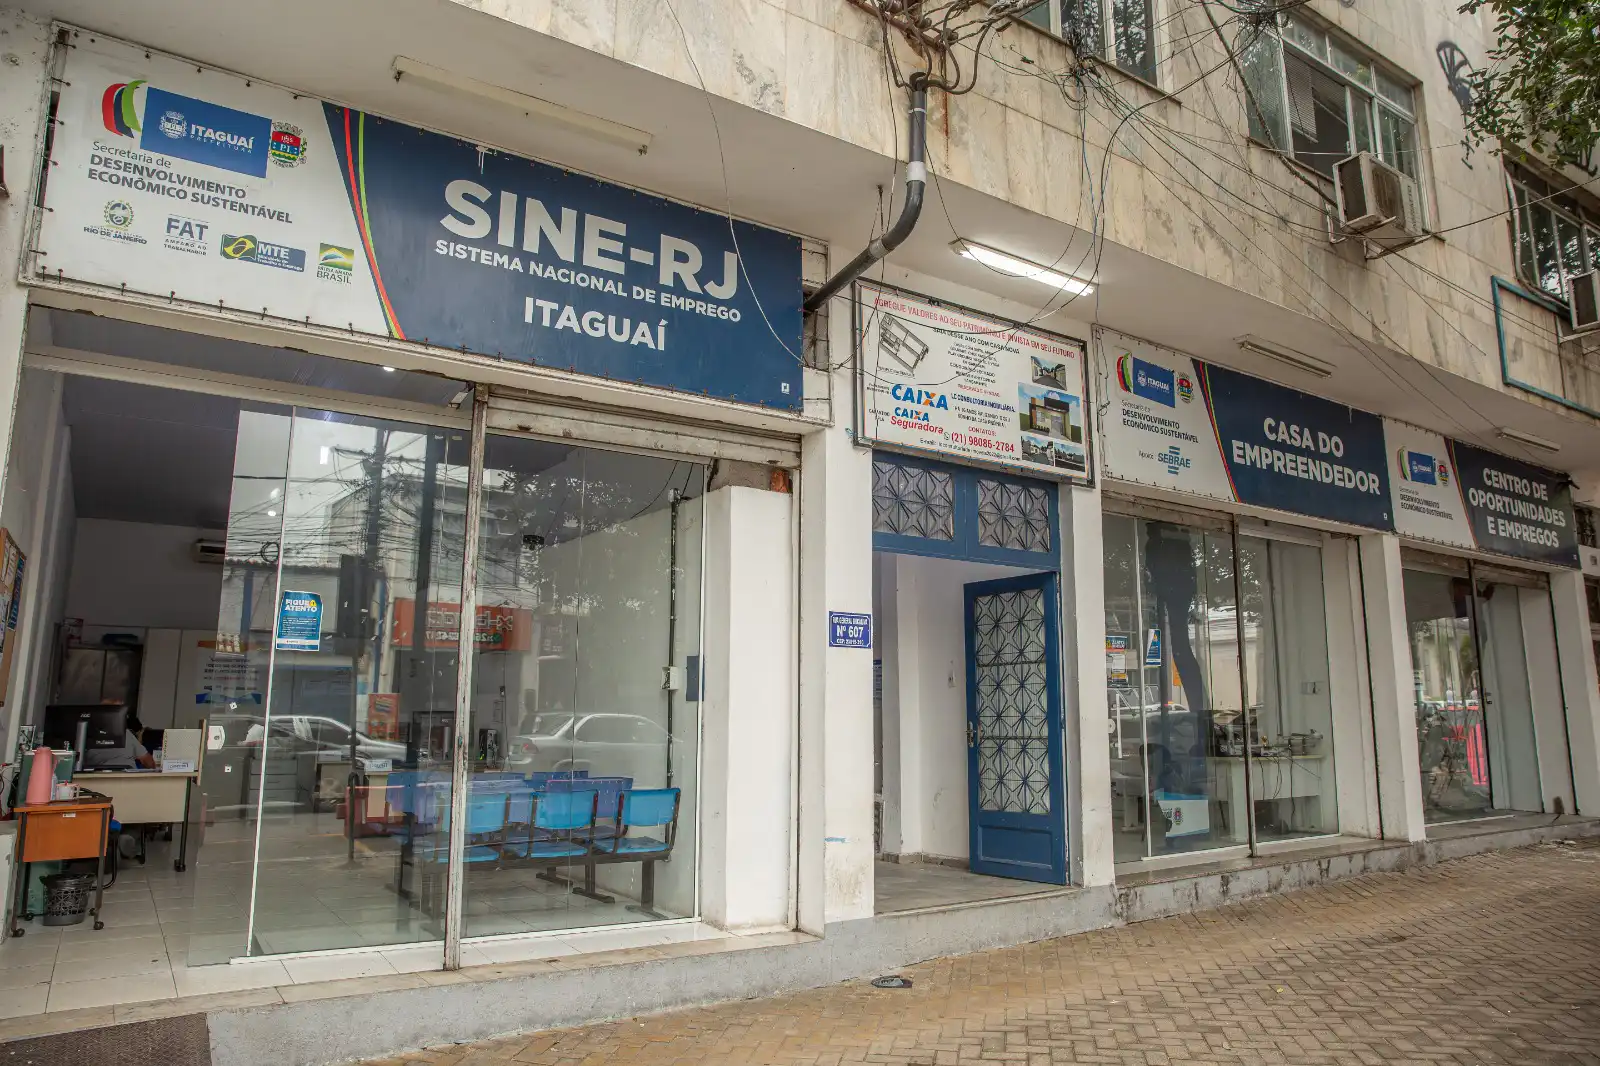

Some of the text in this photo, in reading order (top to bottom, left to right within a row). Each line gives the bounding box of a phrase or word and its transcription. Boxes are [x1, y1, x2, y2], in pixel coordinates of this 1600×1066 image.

[191, 124, 255, 149] ITAGUAÍ
[92, 141, 171, 168] Secretaria de
[90, 154, 246, 198] DESENVOLVIMENTO
[88, 168, 293, 224] ECONÔMICO SUSTENTÁVEL
[83, 226, 99, 235] RIO
[100, 230, 111, 238] DE
[113, 233, 148, 245] JANEIRO
[166, 217, 209, 241] FAT
[439, 179, 738, 300] SINE-RJ
[163, 243, 207, 256] TRABALHADOR
[165, 239, 195, 248] AMPARO
[258, 243, 290, 260] MTE
[316, 270, 352, 285] BRASIL
[435, 239, 742, 323] SISTEMA NACIONAL DE EMPREGO
[524, 296, 669, 351] ITAGUAÍ
[874, 297, 906, 312] AGREGUE
[908, 306, 938, 321] VALORES
[939, 316, 949, 324] AO
[949, 318, 962, 327] SEU
[1031, 340, 1040, 349] EM
[1040, 344, 1052, 352] SEU
[1052, 346, 1075, 358] FUTURO
[977, 338, 989, 346] COM
[892, 384, 948, 410] CAIXA
[890, 416, 944, 434] Seguradora
[894, 406, 930, 422] CAIXA
[1122, 408, 1180, 430] DESENVOLVIMENTO
[951, 432, 967, 446] (21)
[968, 426, 997, 436] CONTATOS:
[1122, 418, 1199, 444] ECONÔMICO SUSTENTÁVEL
[1264, 417, 1344, 458] CASA DO
[1158, 452, 1191, 468] SEBRAE
[1231, 439, 1381, 496] EMPREENDEDOR
[1482, 467, 1549, 501] CENTRO DE
[1400, 494, 1440, 509] DESENVOLVIMENTO
[1400, 502, 1454, 520] ECONÔMICO SUSTENTÁVEL
[1468, 487, 1566, 528] OPORTUNIDADES
[1486, 516, 1560, 548] E EMPREGOS
[286, 598, 310, 606] FIQUE
[836, 624, 864, 638] Nº 607
